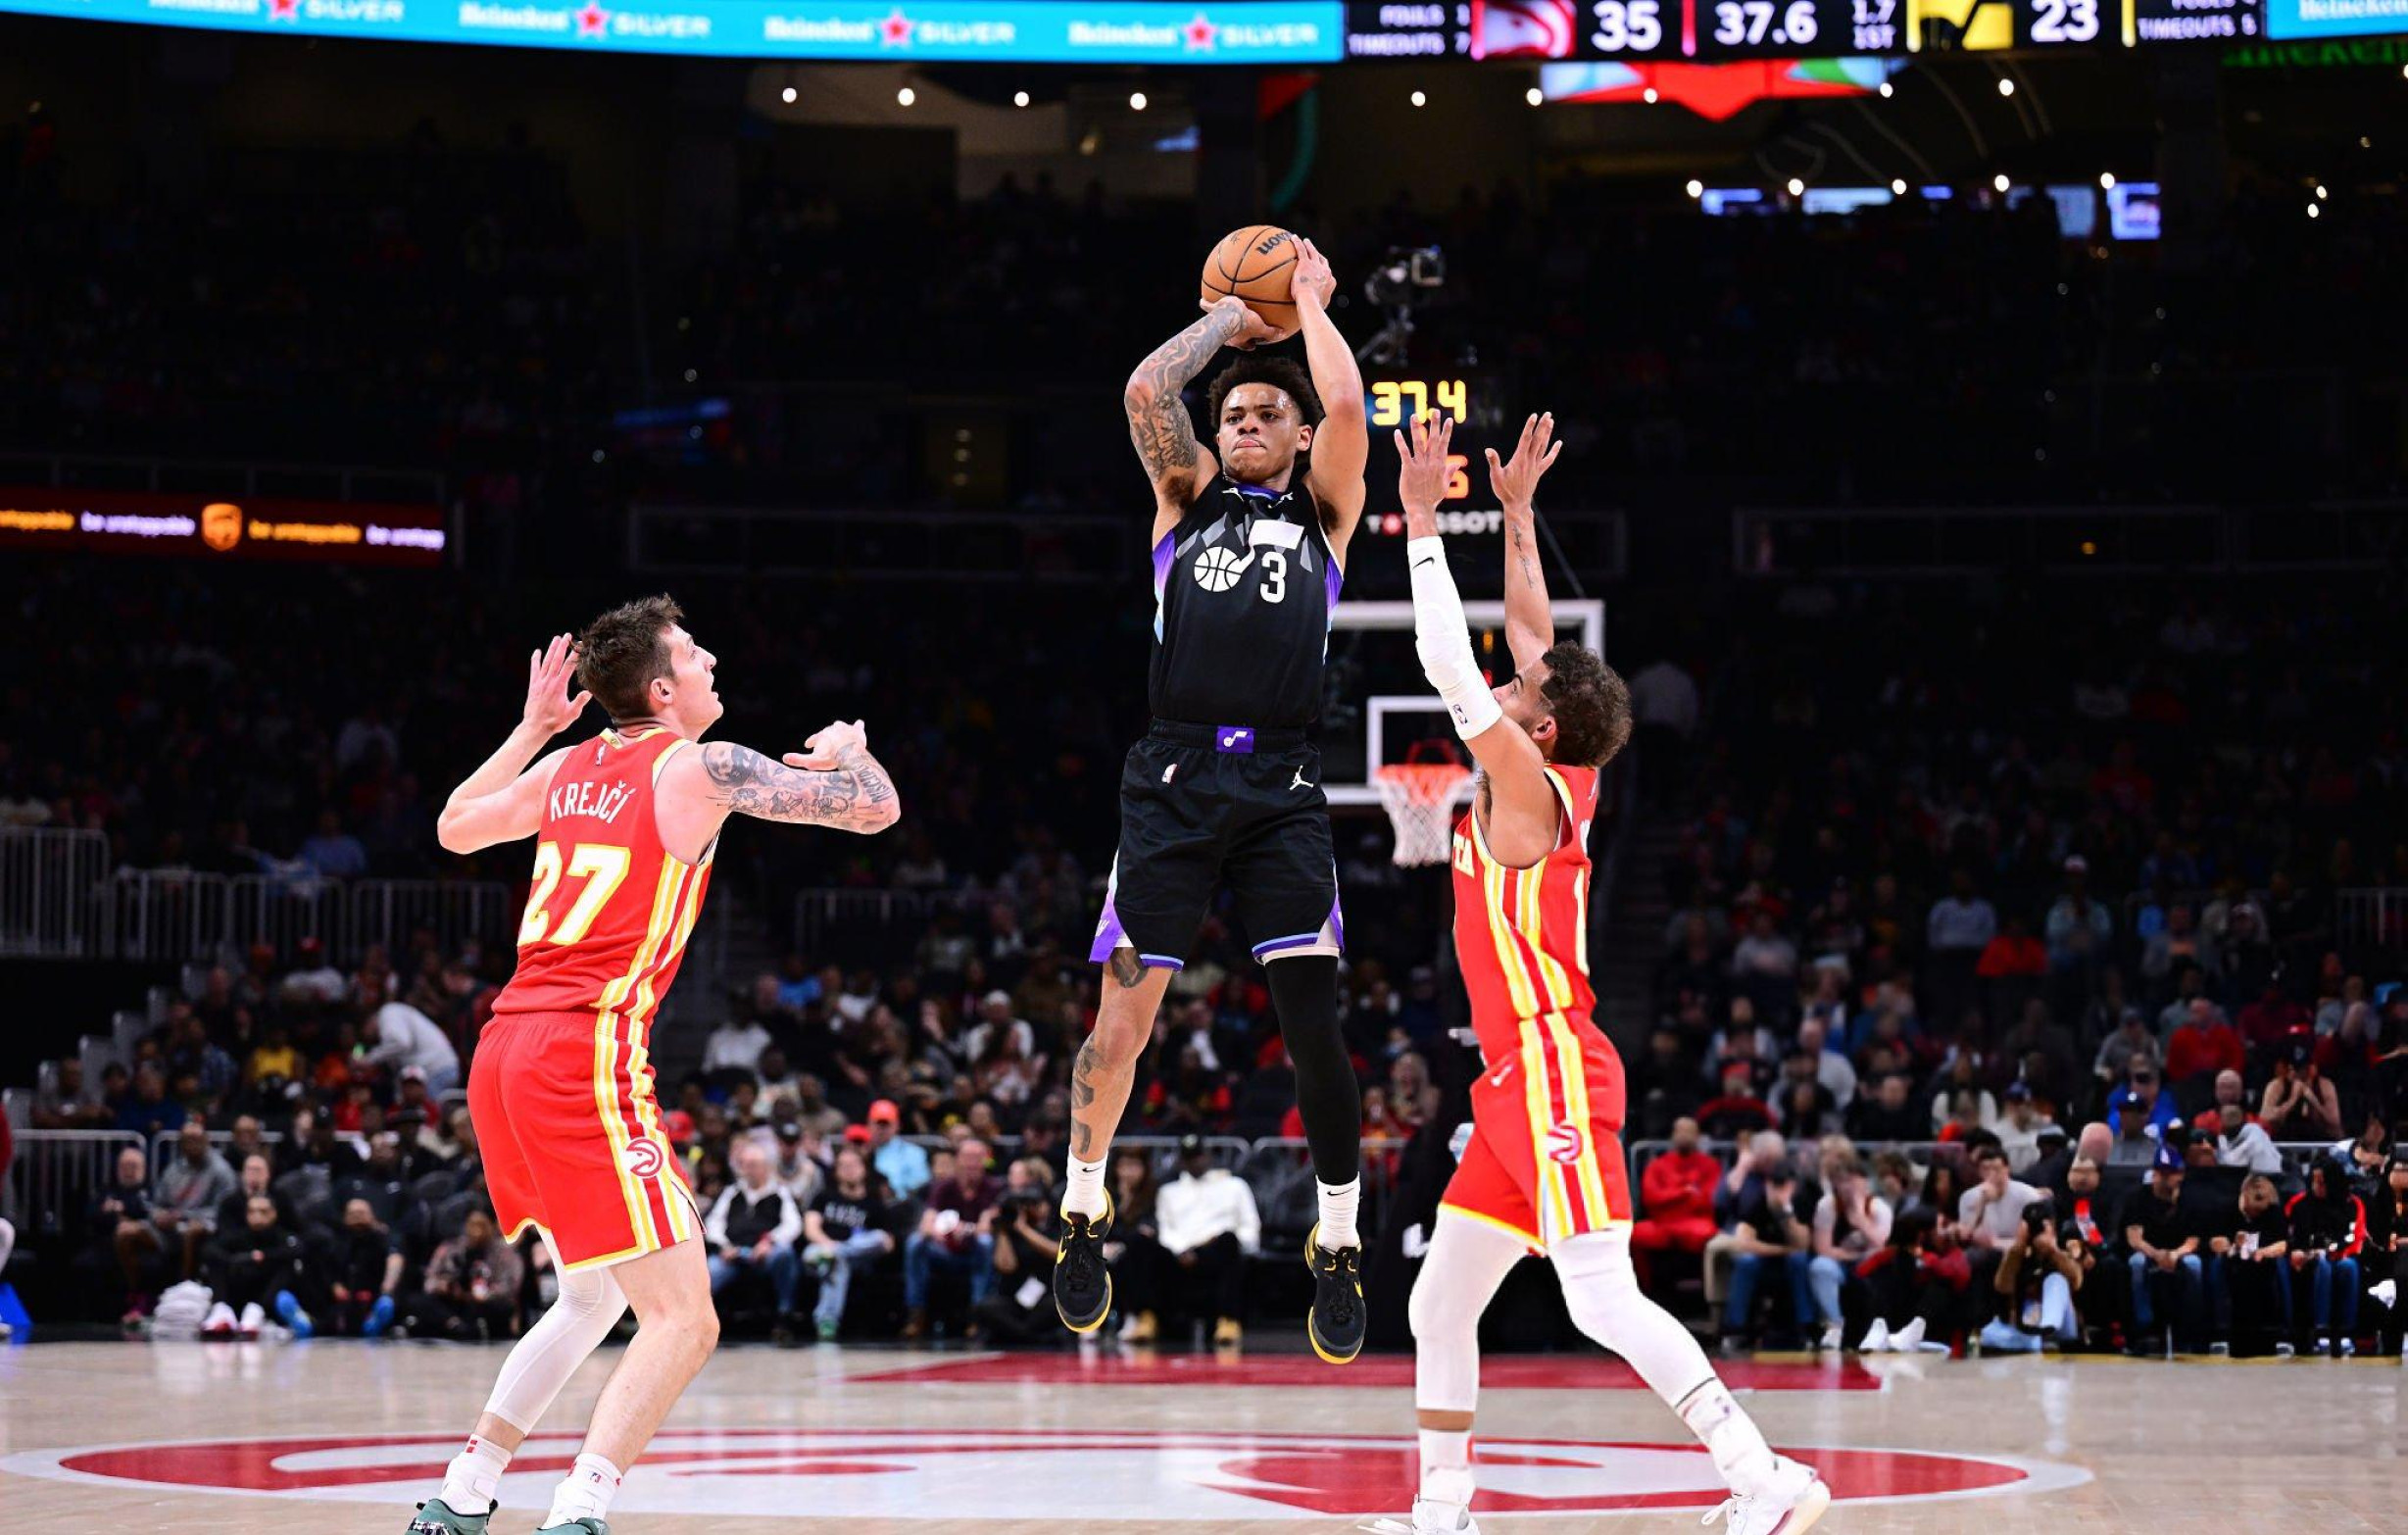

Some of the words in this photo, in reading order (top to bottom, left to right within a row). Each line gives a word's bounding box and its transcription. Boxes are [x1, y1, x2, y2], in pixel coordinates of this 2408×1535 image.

[1591, 0, 1663, 52] 35
[1714, 0, 1819, 45] 37.6
[2031, 0, 2100, 42] 23
[1372, 379, 1466, 426] 37.4
[1259, 551, 1287, 604] 3
[551, 779, 636, 824] KREJČÍ
[516, 840, 632, 946] 27
